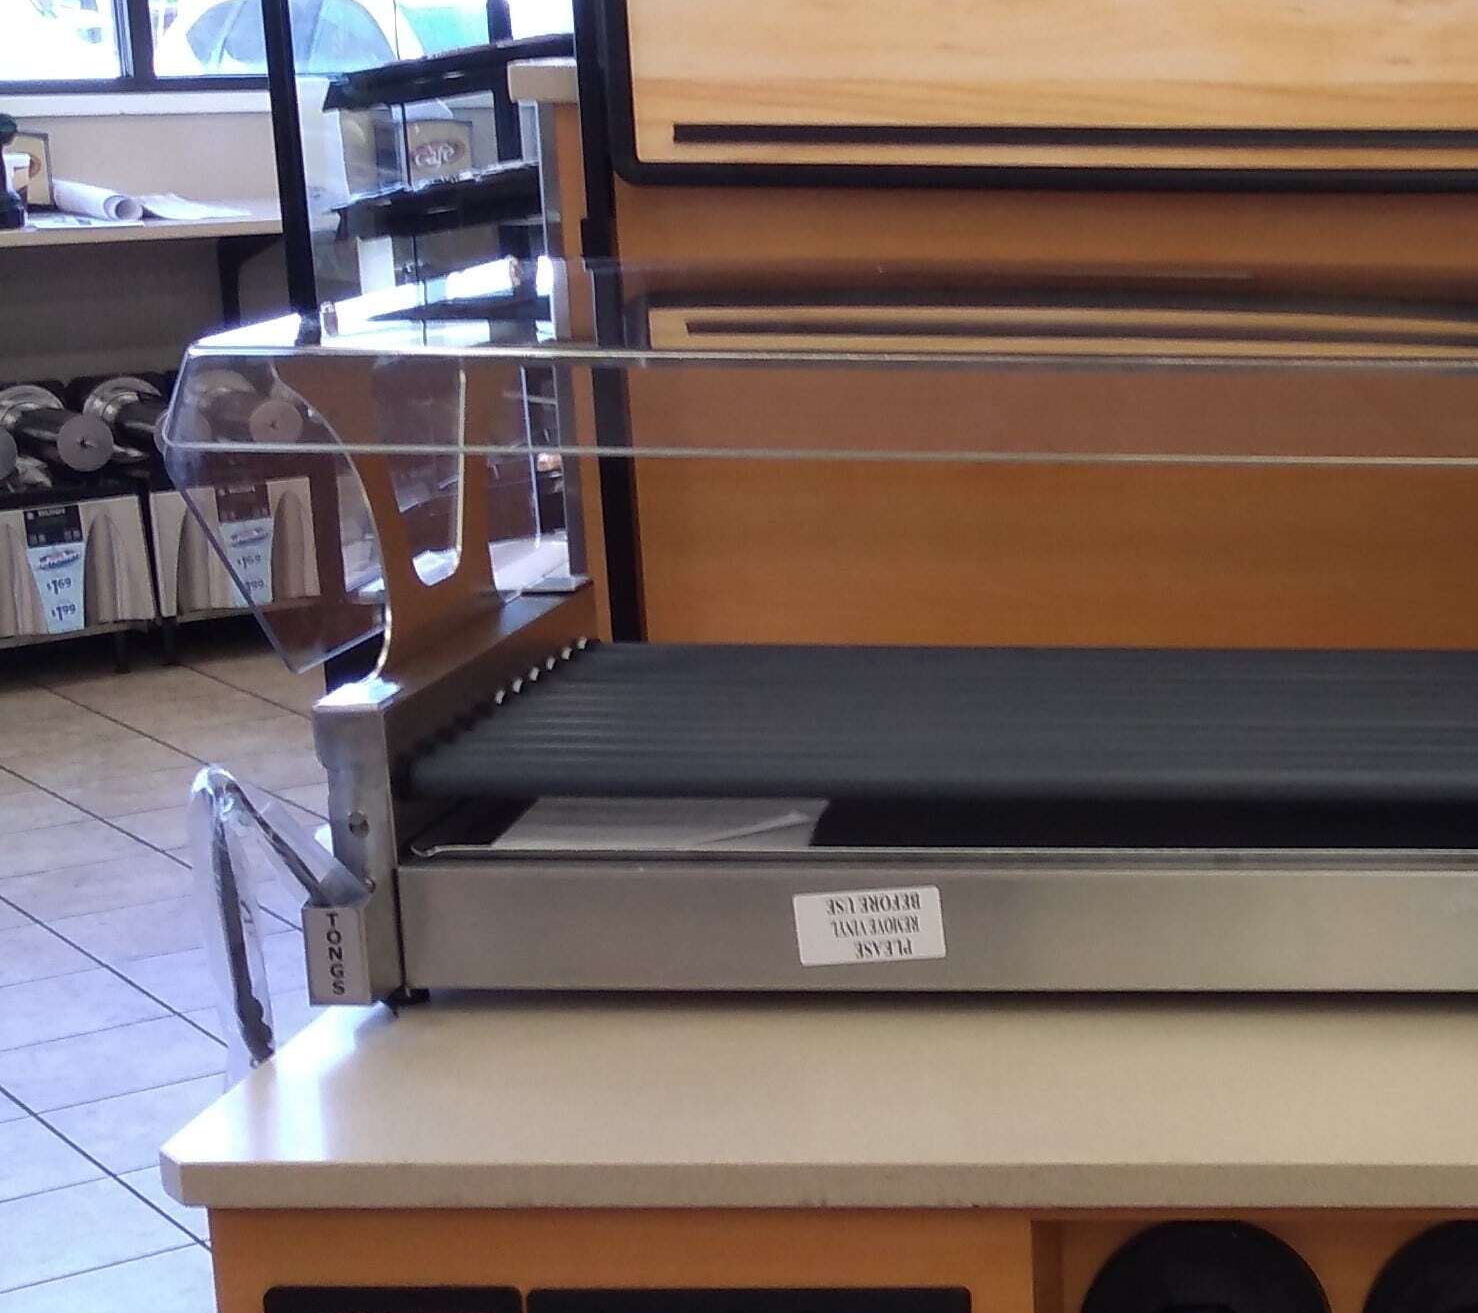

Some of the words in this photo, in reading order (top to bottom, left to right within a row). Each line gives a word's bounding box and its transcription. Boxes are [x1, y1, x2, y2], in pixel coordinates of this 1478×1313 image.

[826, 896, 856, 916] USE
[859, 893, 921, 915] BEFORE
[831, 919, 866, 937] VINYL
[870, 915, 919, 934] REMOVE
[326, 912, 346, 996] TONGS
[855, 939, 913, 959] PLEASE
